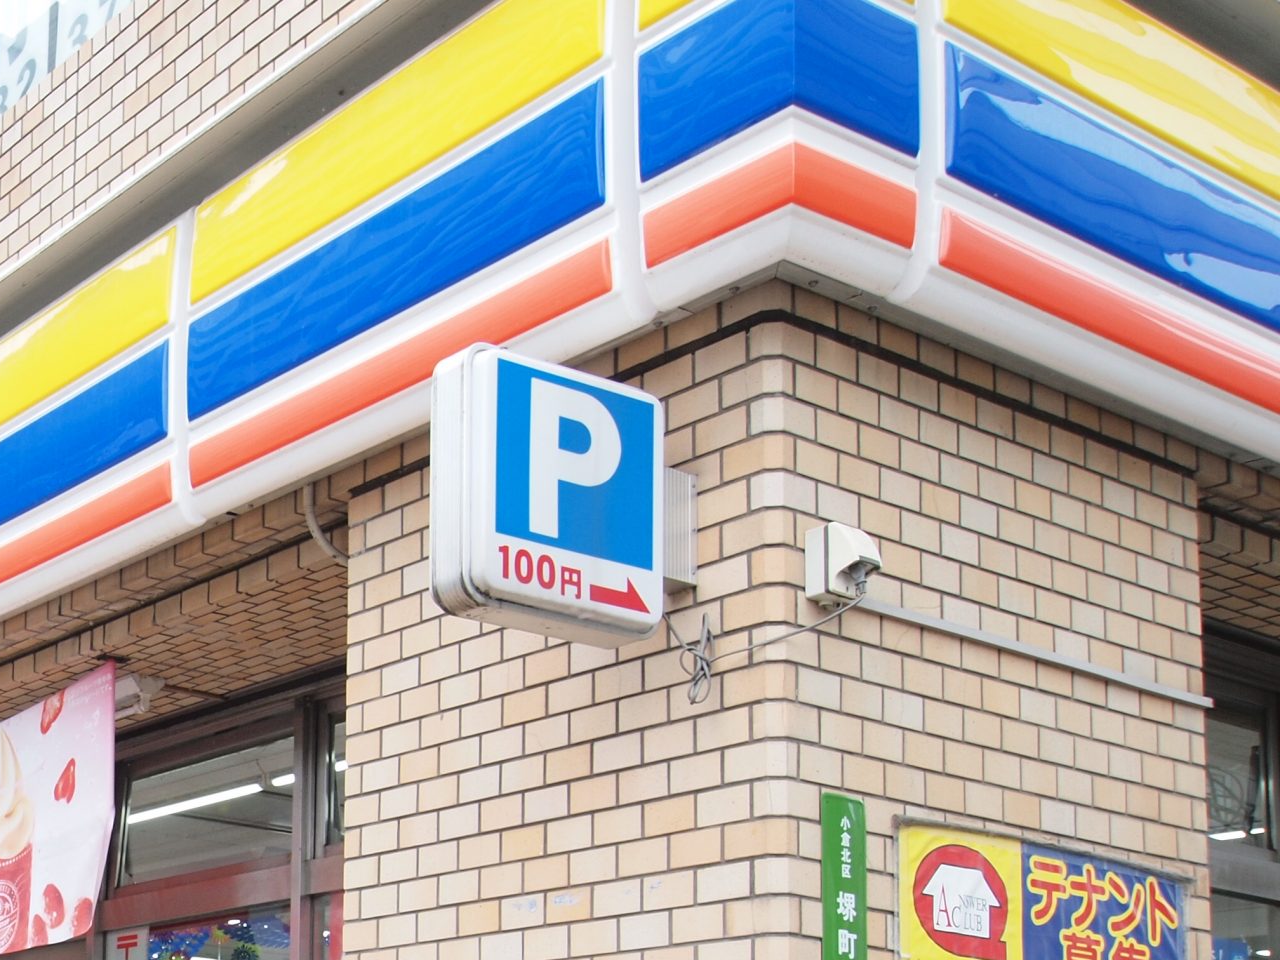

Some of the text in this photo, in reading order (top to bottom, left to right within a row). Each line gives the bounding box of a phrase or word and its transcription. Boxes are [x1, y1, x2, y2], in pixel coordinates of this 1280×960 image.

[529, 376, 622, 539] P
[498, 544, 582, 600] 100円
[839, 815, 852, 879] 小倉北区
[1028, 856, 1178, 947] テナント
